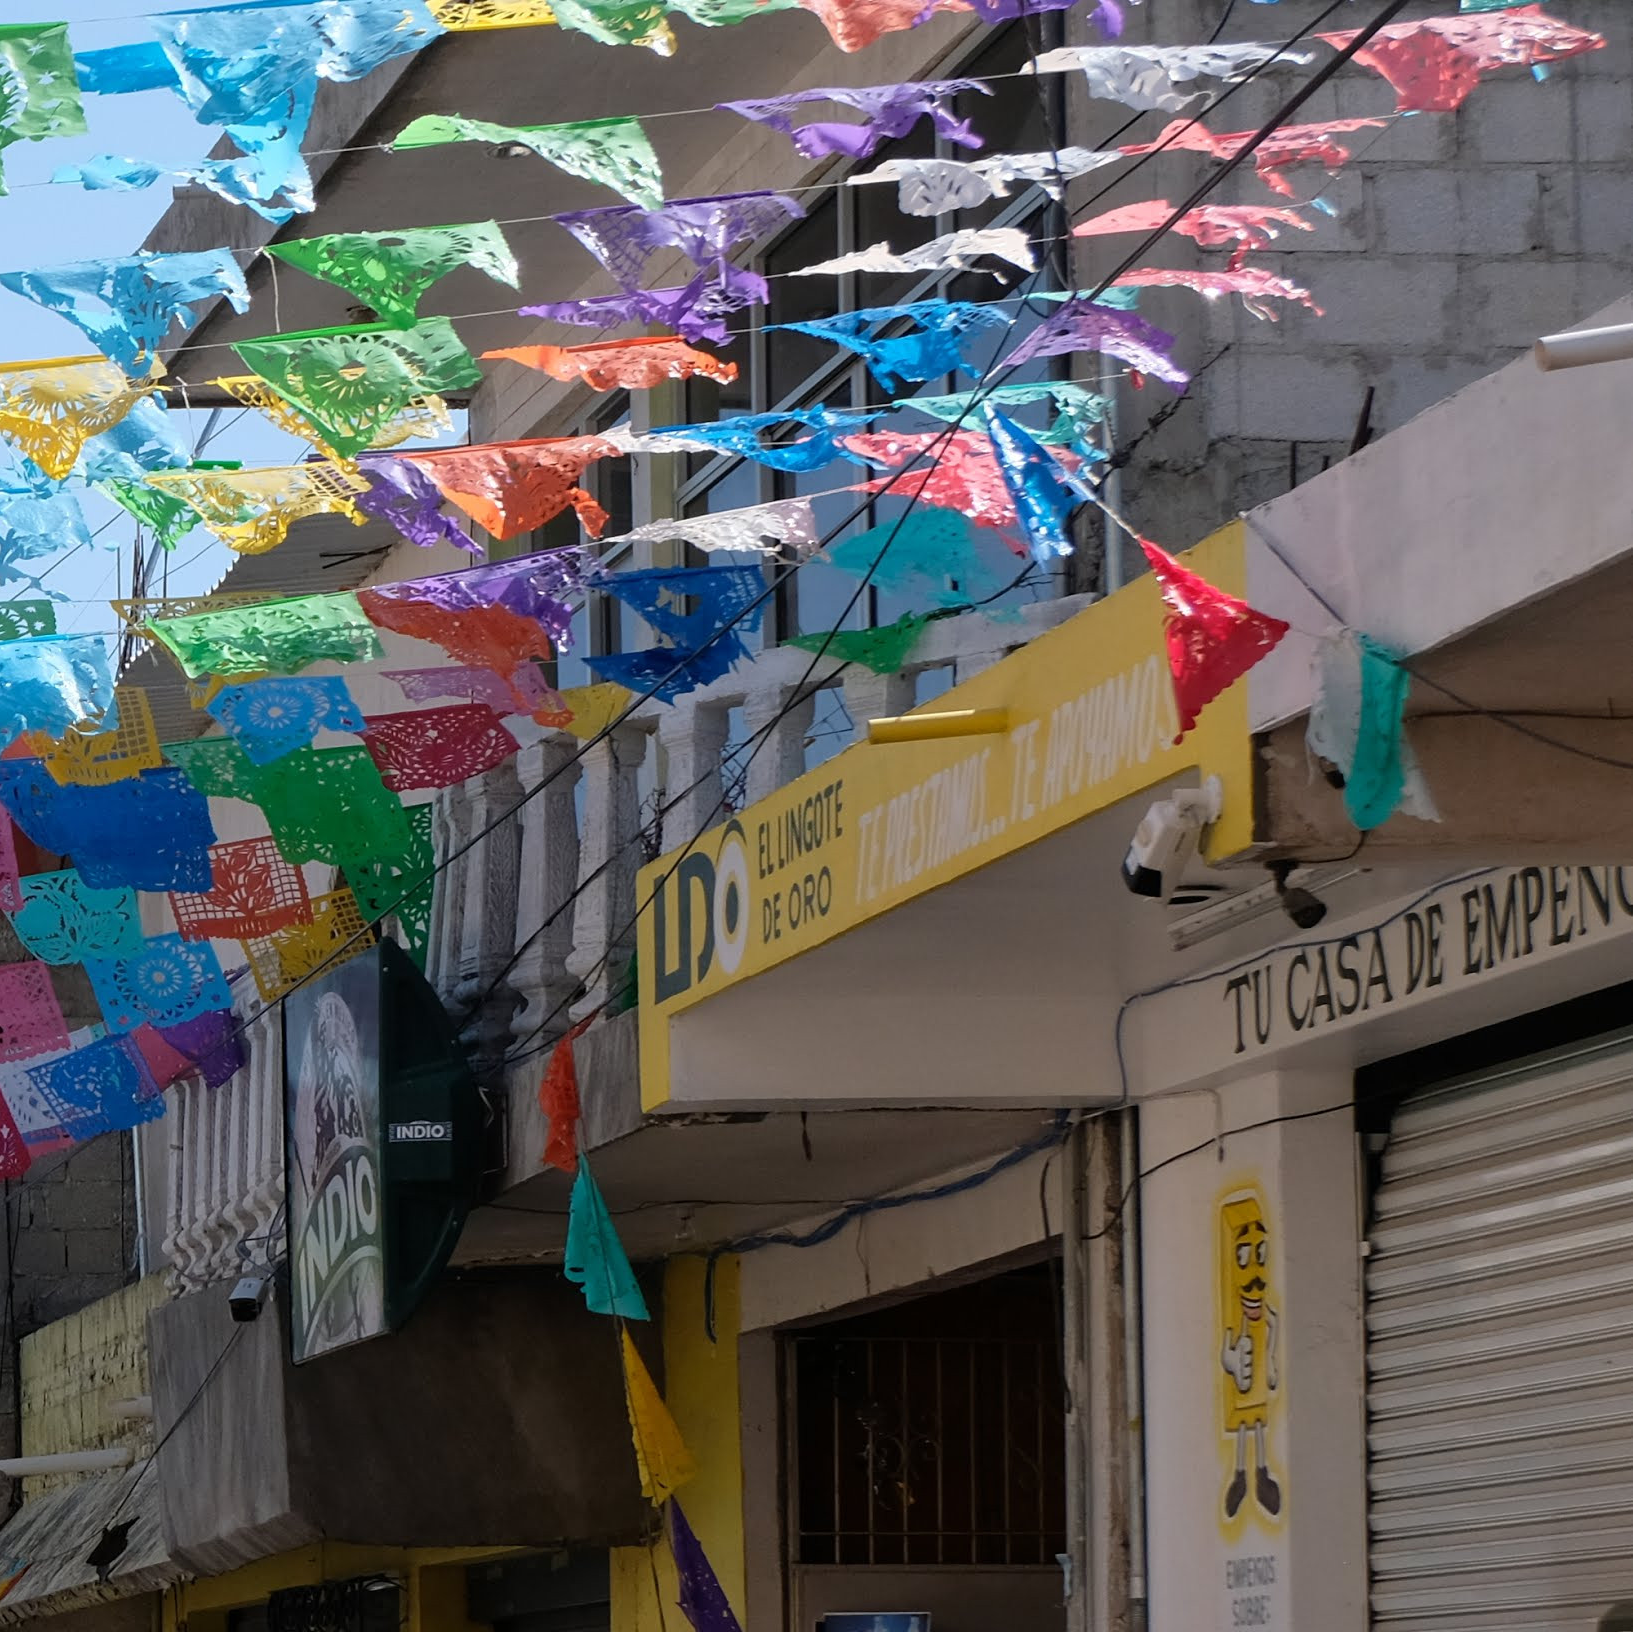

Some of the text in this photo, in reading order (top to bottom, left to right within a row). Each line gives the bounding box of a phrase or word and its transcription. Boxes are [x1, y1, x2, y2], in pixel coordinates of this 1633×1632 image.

[758, 778, 843, 879] EL LINGOTE
[763, 865, 832, 945] DE ORO
[1222, 964, 1273, 1054] TU
[1286, 927, 1393, 1032] CASA
[1403, 903, 1446, 995] DE
[395, 1124, 445, 1139] INDIO
[298, 1155, 377, 1337] INDIO
